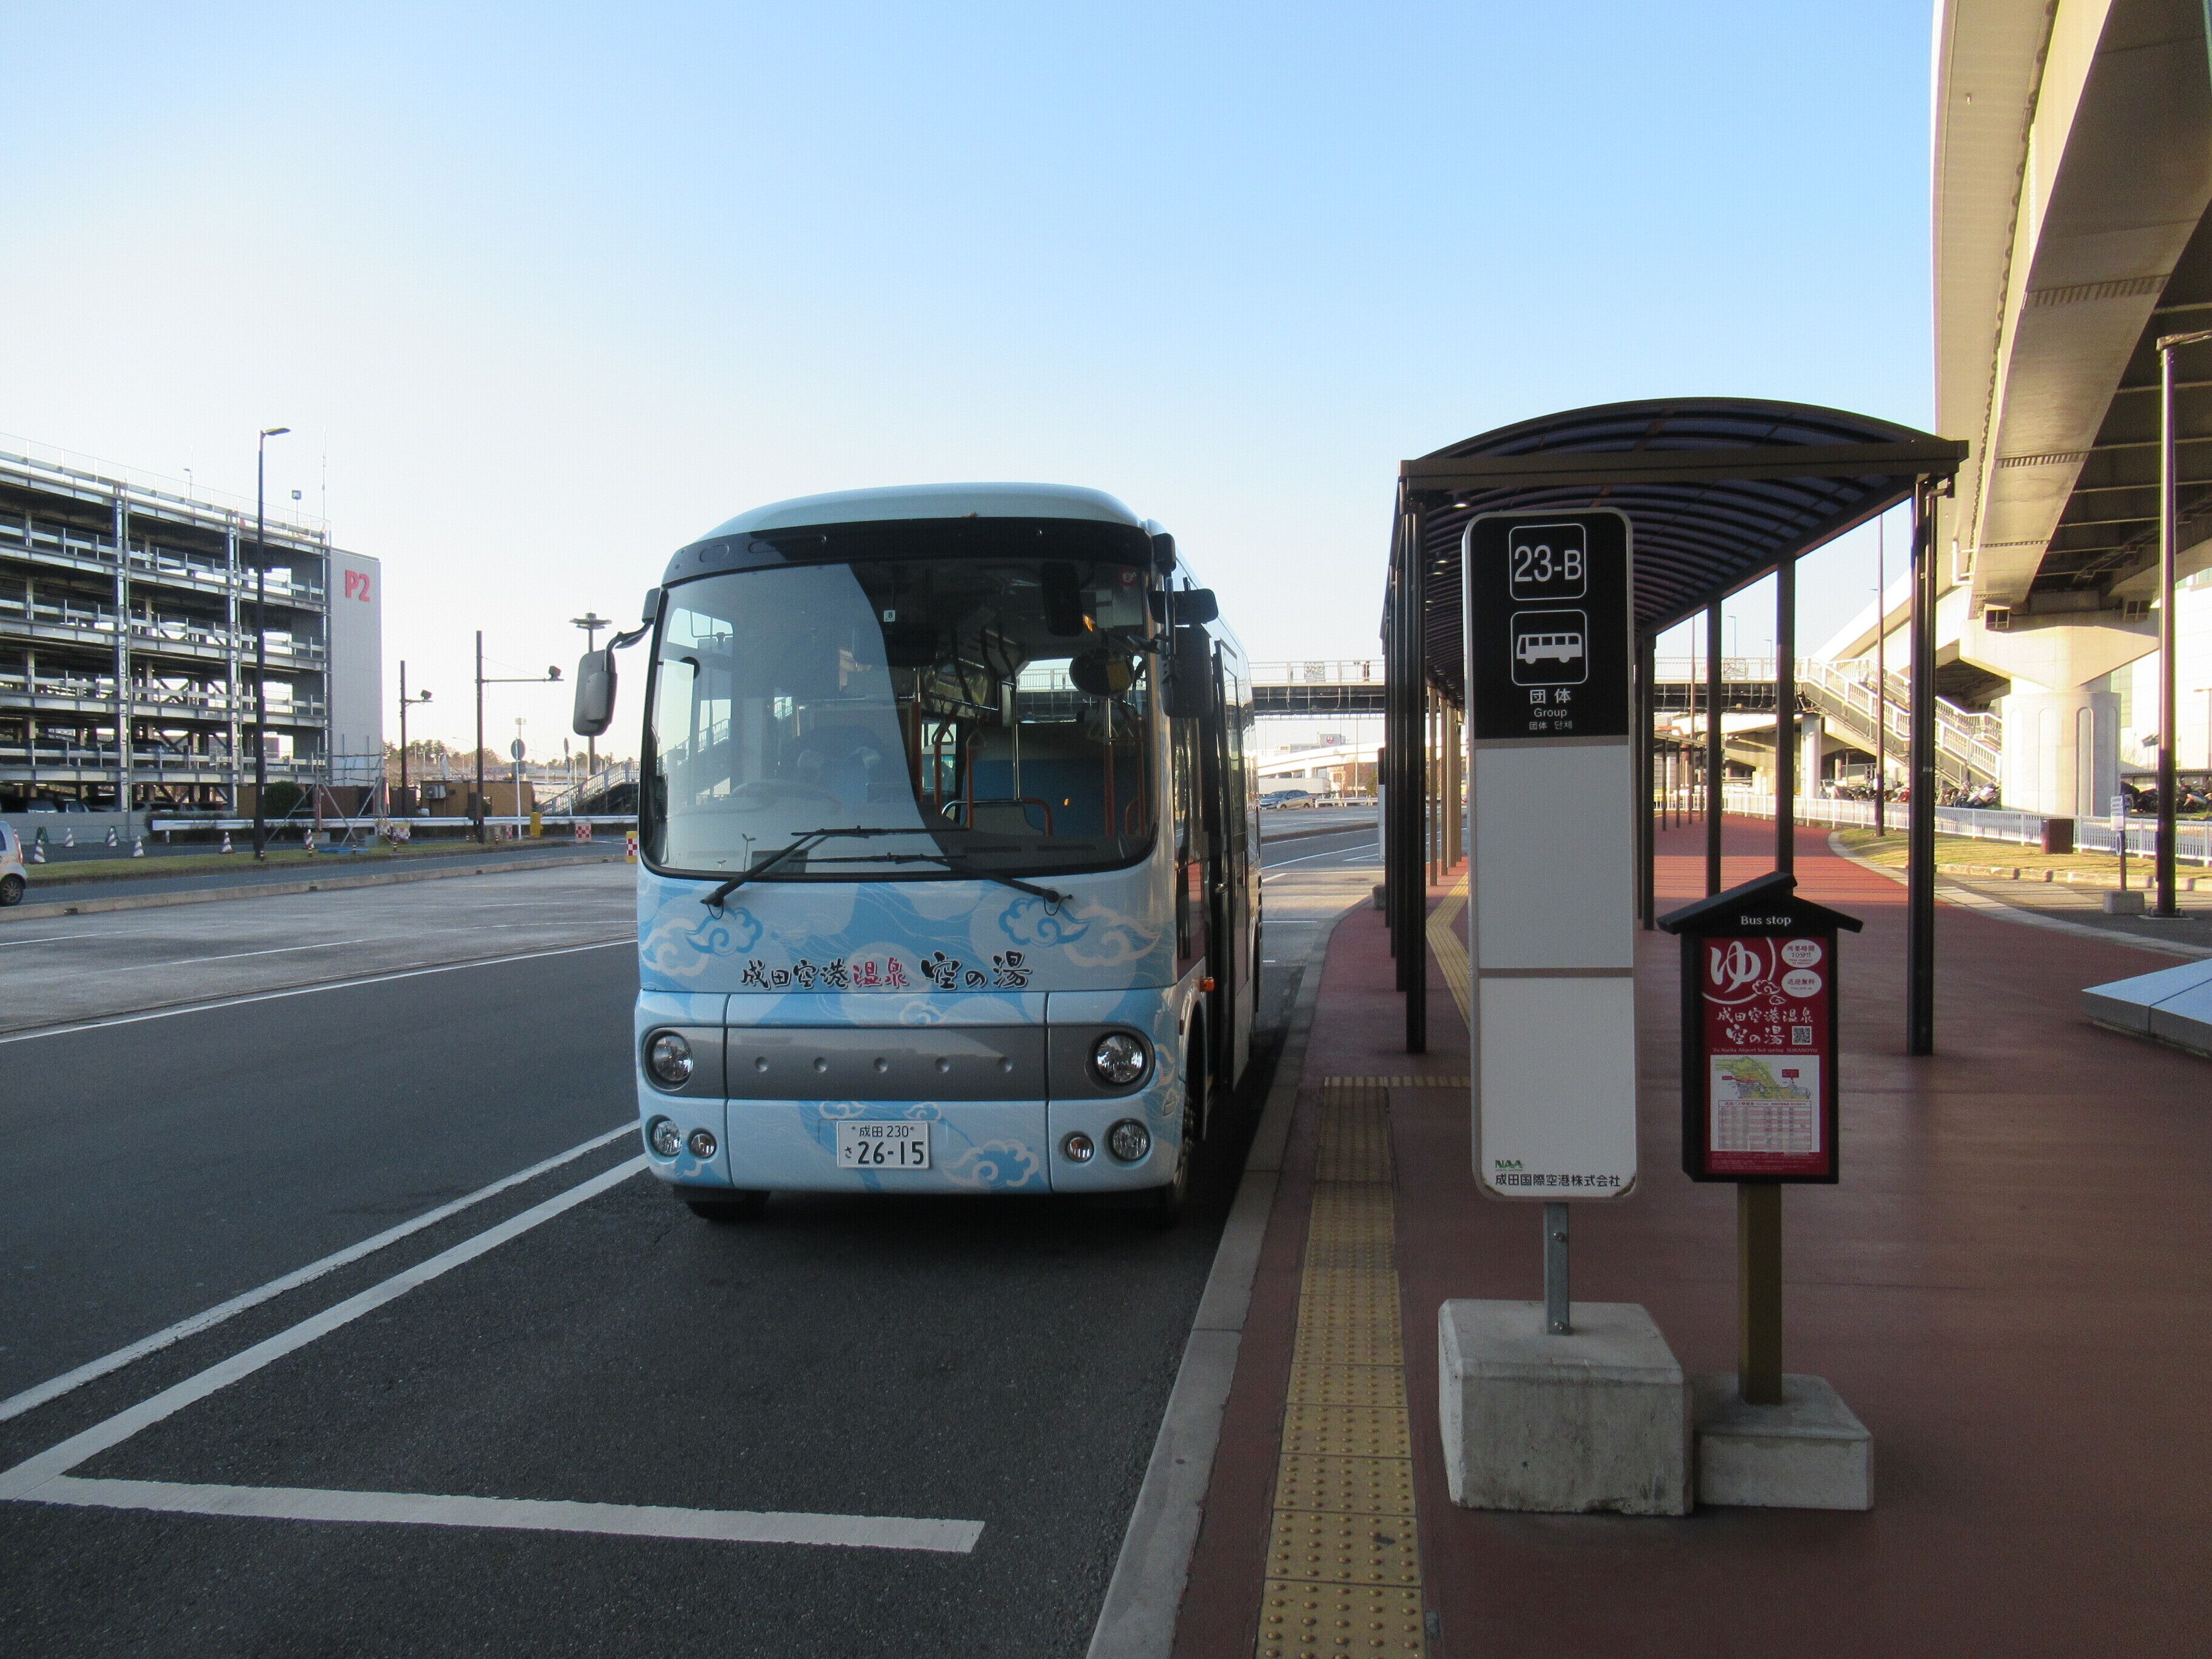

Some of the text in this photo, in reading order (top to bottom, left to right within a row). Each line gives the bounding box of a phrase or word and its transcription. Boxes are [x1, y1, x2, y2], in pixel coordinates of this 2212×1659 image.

[1514, 545, 1581, 581] 23-B
[345, 569, 371, 602] P2
[1530, 688, 1572, 705] 団体
[1534, 708, 1567, 719] Group
[1741, 916, 1791, 927] Bus stop
[741, 951, 1033, 990] 成田空港温泉 空の湯
[1710, 941, 1761, 994] ゆ
[1717, 1007, 1813, 1023] 成田空港温泉
[1726, 1024, 1785, 1045] 空の湯
[859, 1125, 909, 1138] 成田 230
[845, 1141, 924, 1165] さ 26-15
[1495, 1160, 1523, 1169] NAA
[1495, 1173, 1621, 1187] 成田国際空港株式会社
